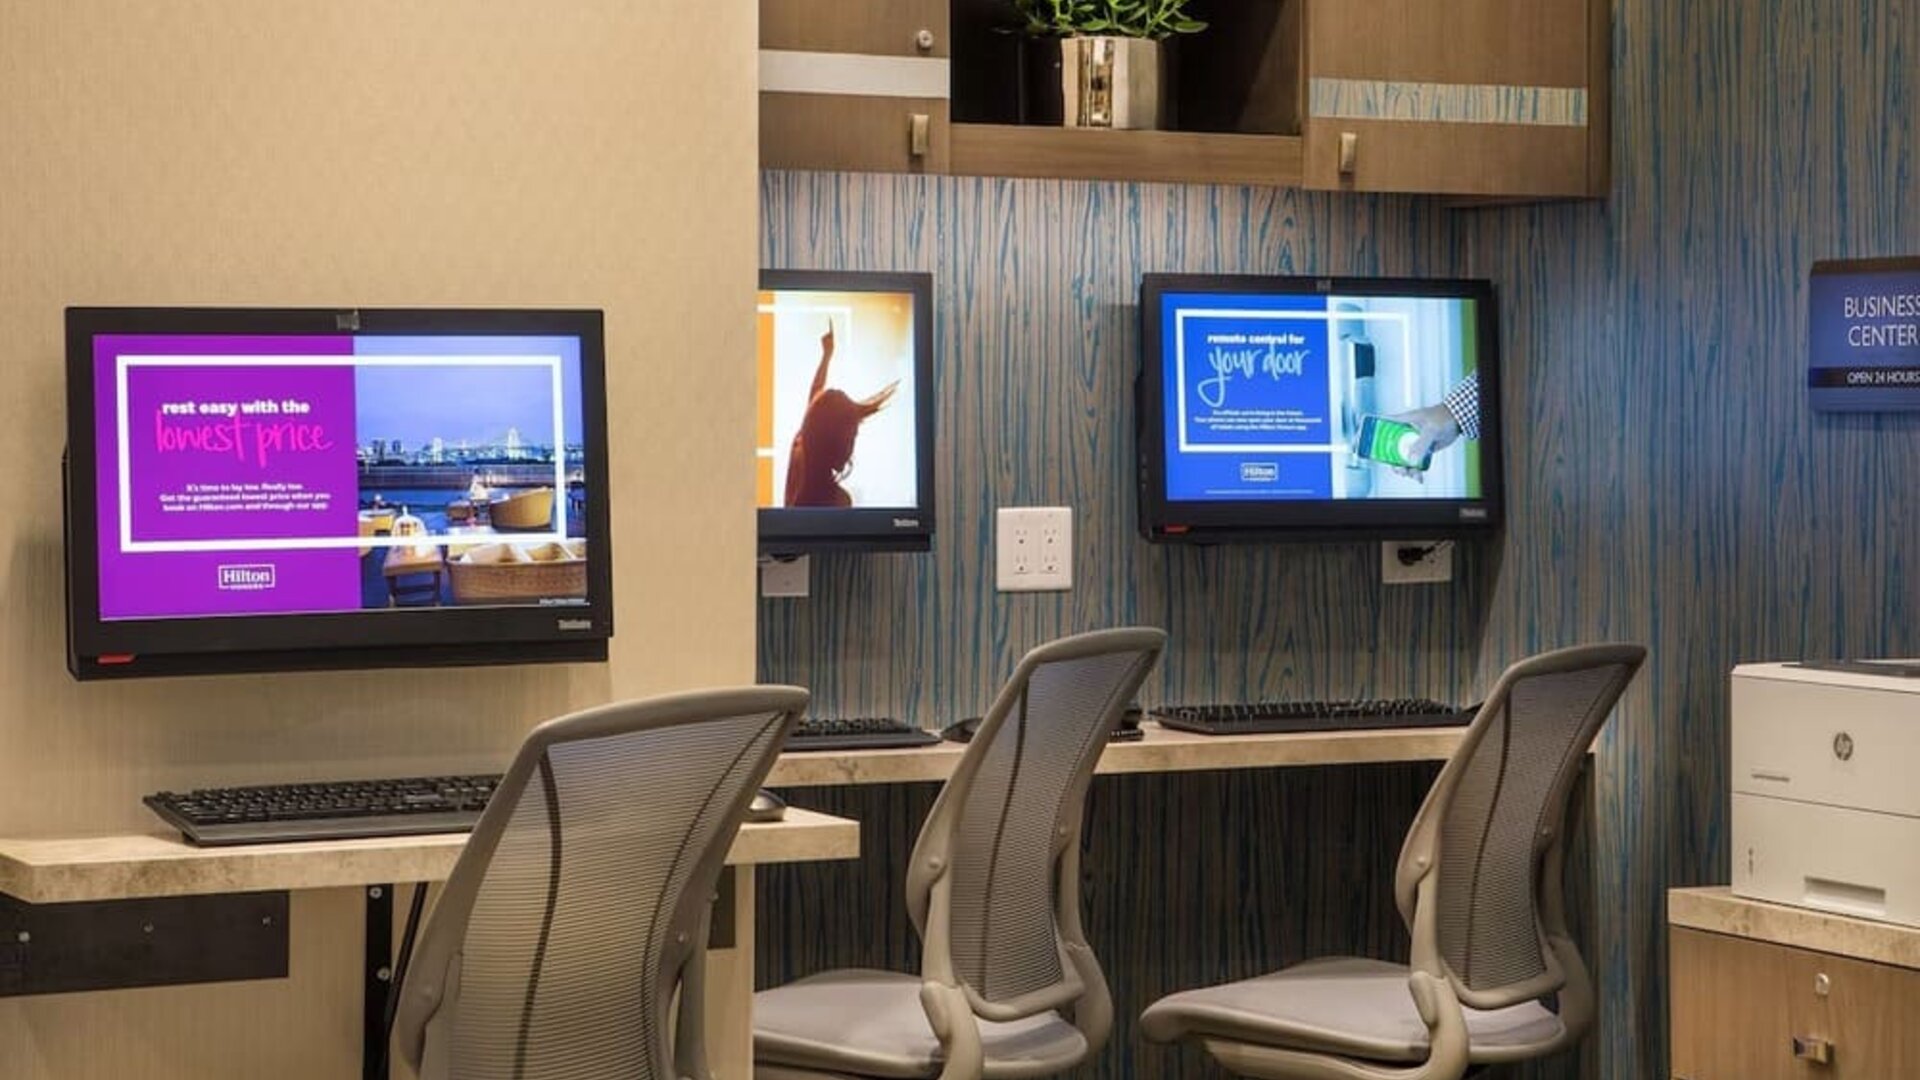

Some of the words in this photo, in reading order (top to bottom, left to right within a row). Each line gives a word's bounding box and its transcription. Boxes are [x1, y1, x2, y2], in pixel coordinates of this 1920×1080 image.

[1207, 334, 1247, 344] remote
[1248, 333, 1287, 345] control
[1288, 333, 1305, 345] for
[1848, 324, 1919, 347] CENTER
[1198, 346, 1262, 408] your
[1262, 341, 1311, 381] door
[1847, 371, 1873, 384] OPEN
[1875, 371, 1886, 384] 24
[162, 402, 196, 415] rest
[199, 403, 238, 417] easy
[240, 400, 279, 414] with
[281, 401, 311, 414] the
[156, 410, 245, 462] lowest
[256, 418, 334, 469] price
[223, 569, 270, 582] Hilton
